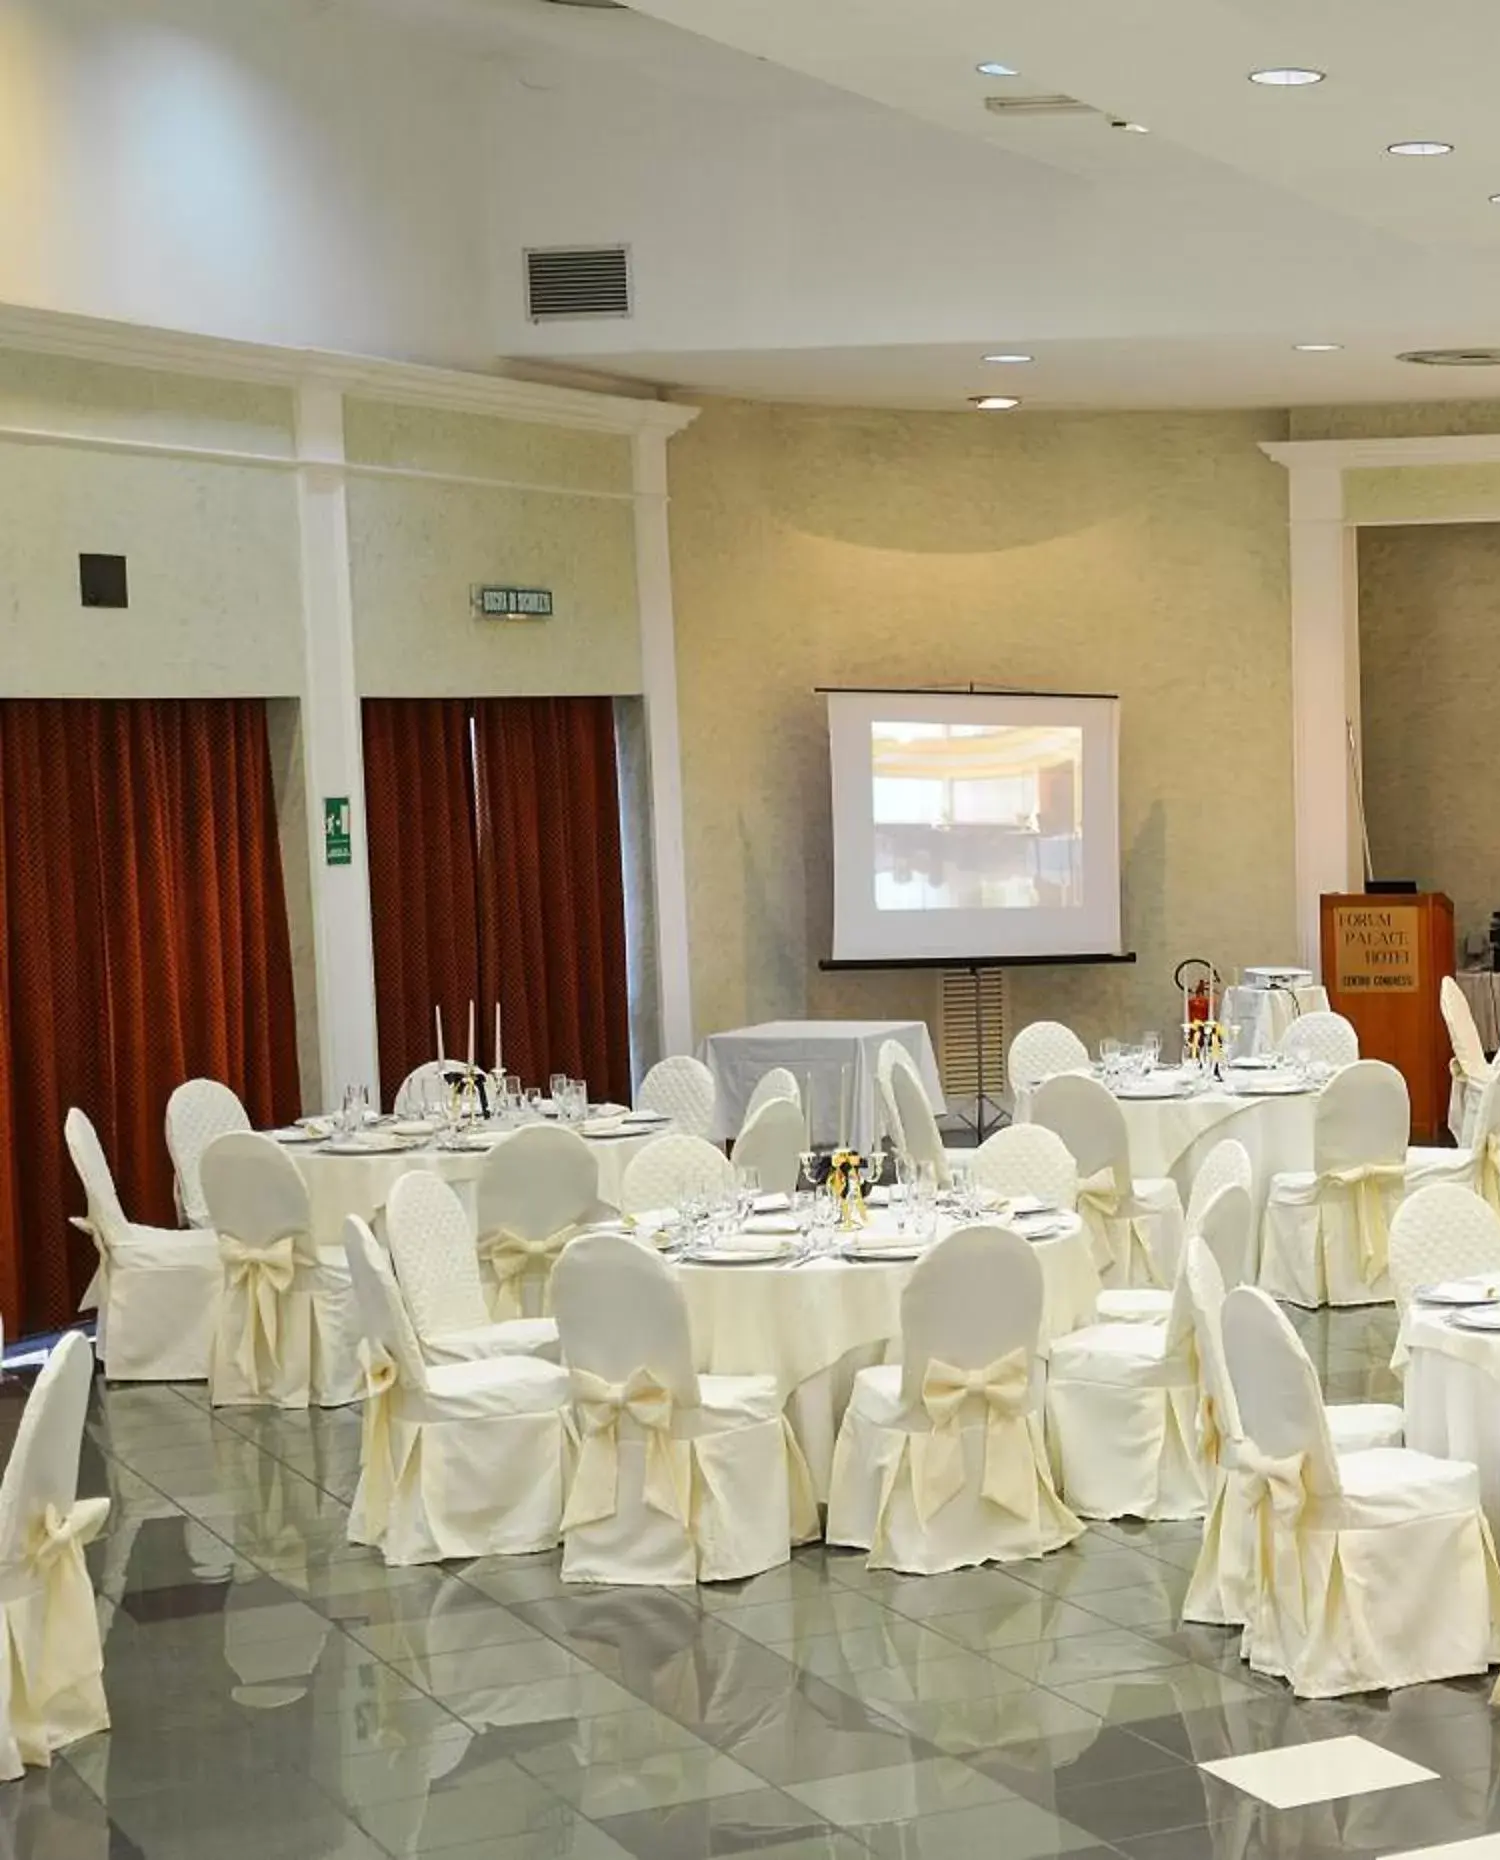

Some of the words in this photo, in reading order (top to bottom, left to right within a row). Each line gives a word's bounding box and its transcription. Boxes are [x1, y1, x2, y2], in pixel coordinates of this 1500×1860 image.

[1339, 912, 1392, 927] FORUM
[1345, 930, 1411, 946] PALACE
[1365, 949, 1410, 965] HOTEL
[1343, 974, 1371, 987] CENTRO
